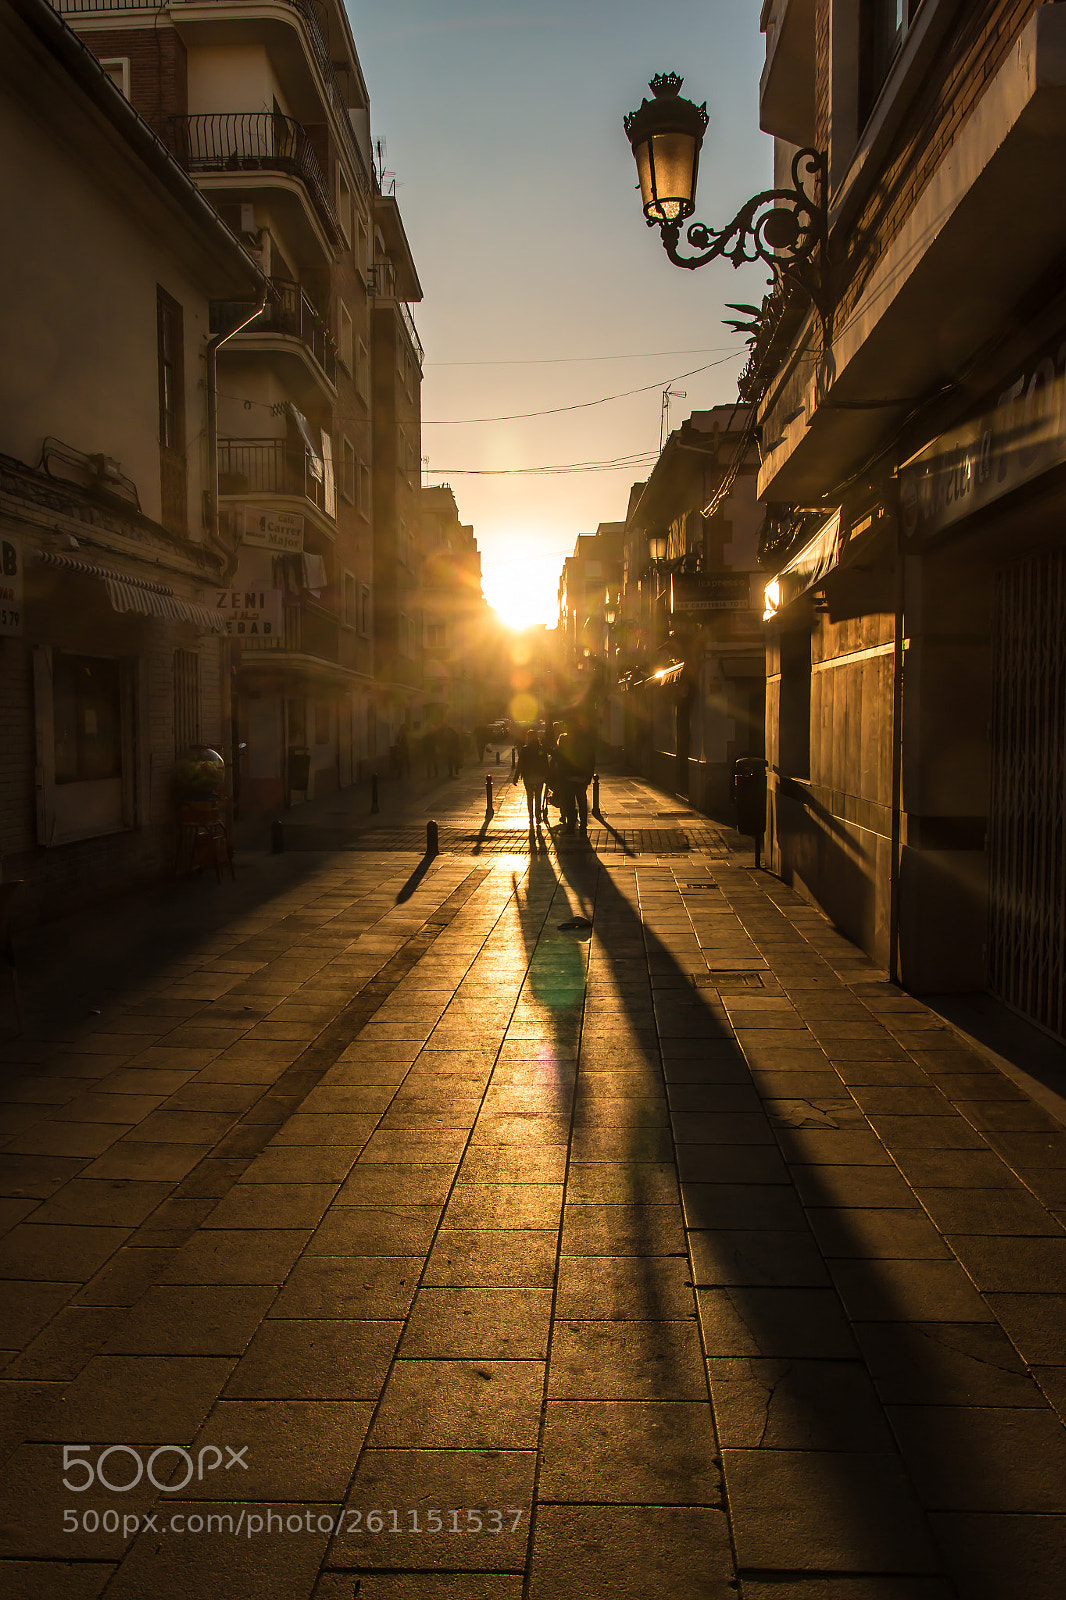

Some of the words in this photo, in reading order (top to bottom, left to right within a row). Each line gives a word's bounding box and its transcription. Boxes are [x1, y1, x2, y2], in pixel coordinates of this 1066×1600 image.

[267, 521, 302, 537] Carrer
[268, 534, 300, 548] Major
[0, 541, 17, 576] B
[216, 592, 265, 608] ZENI
